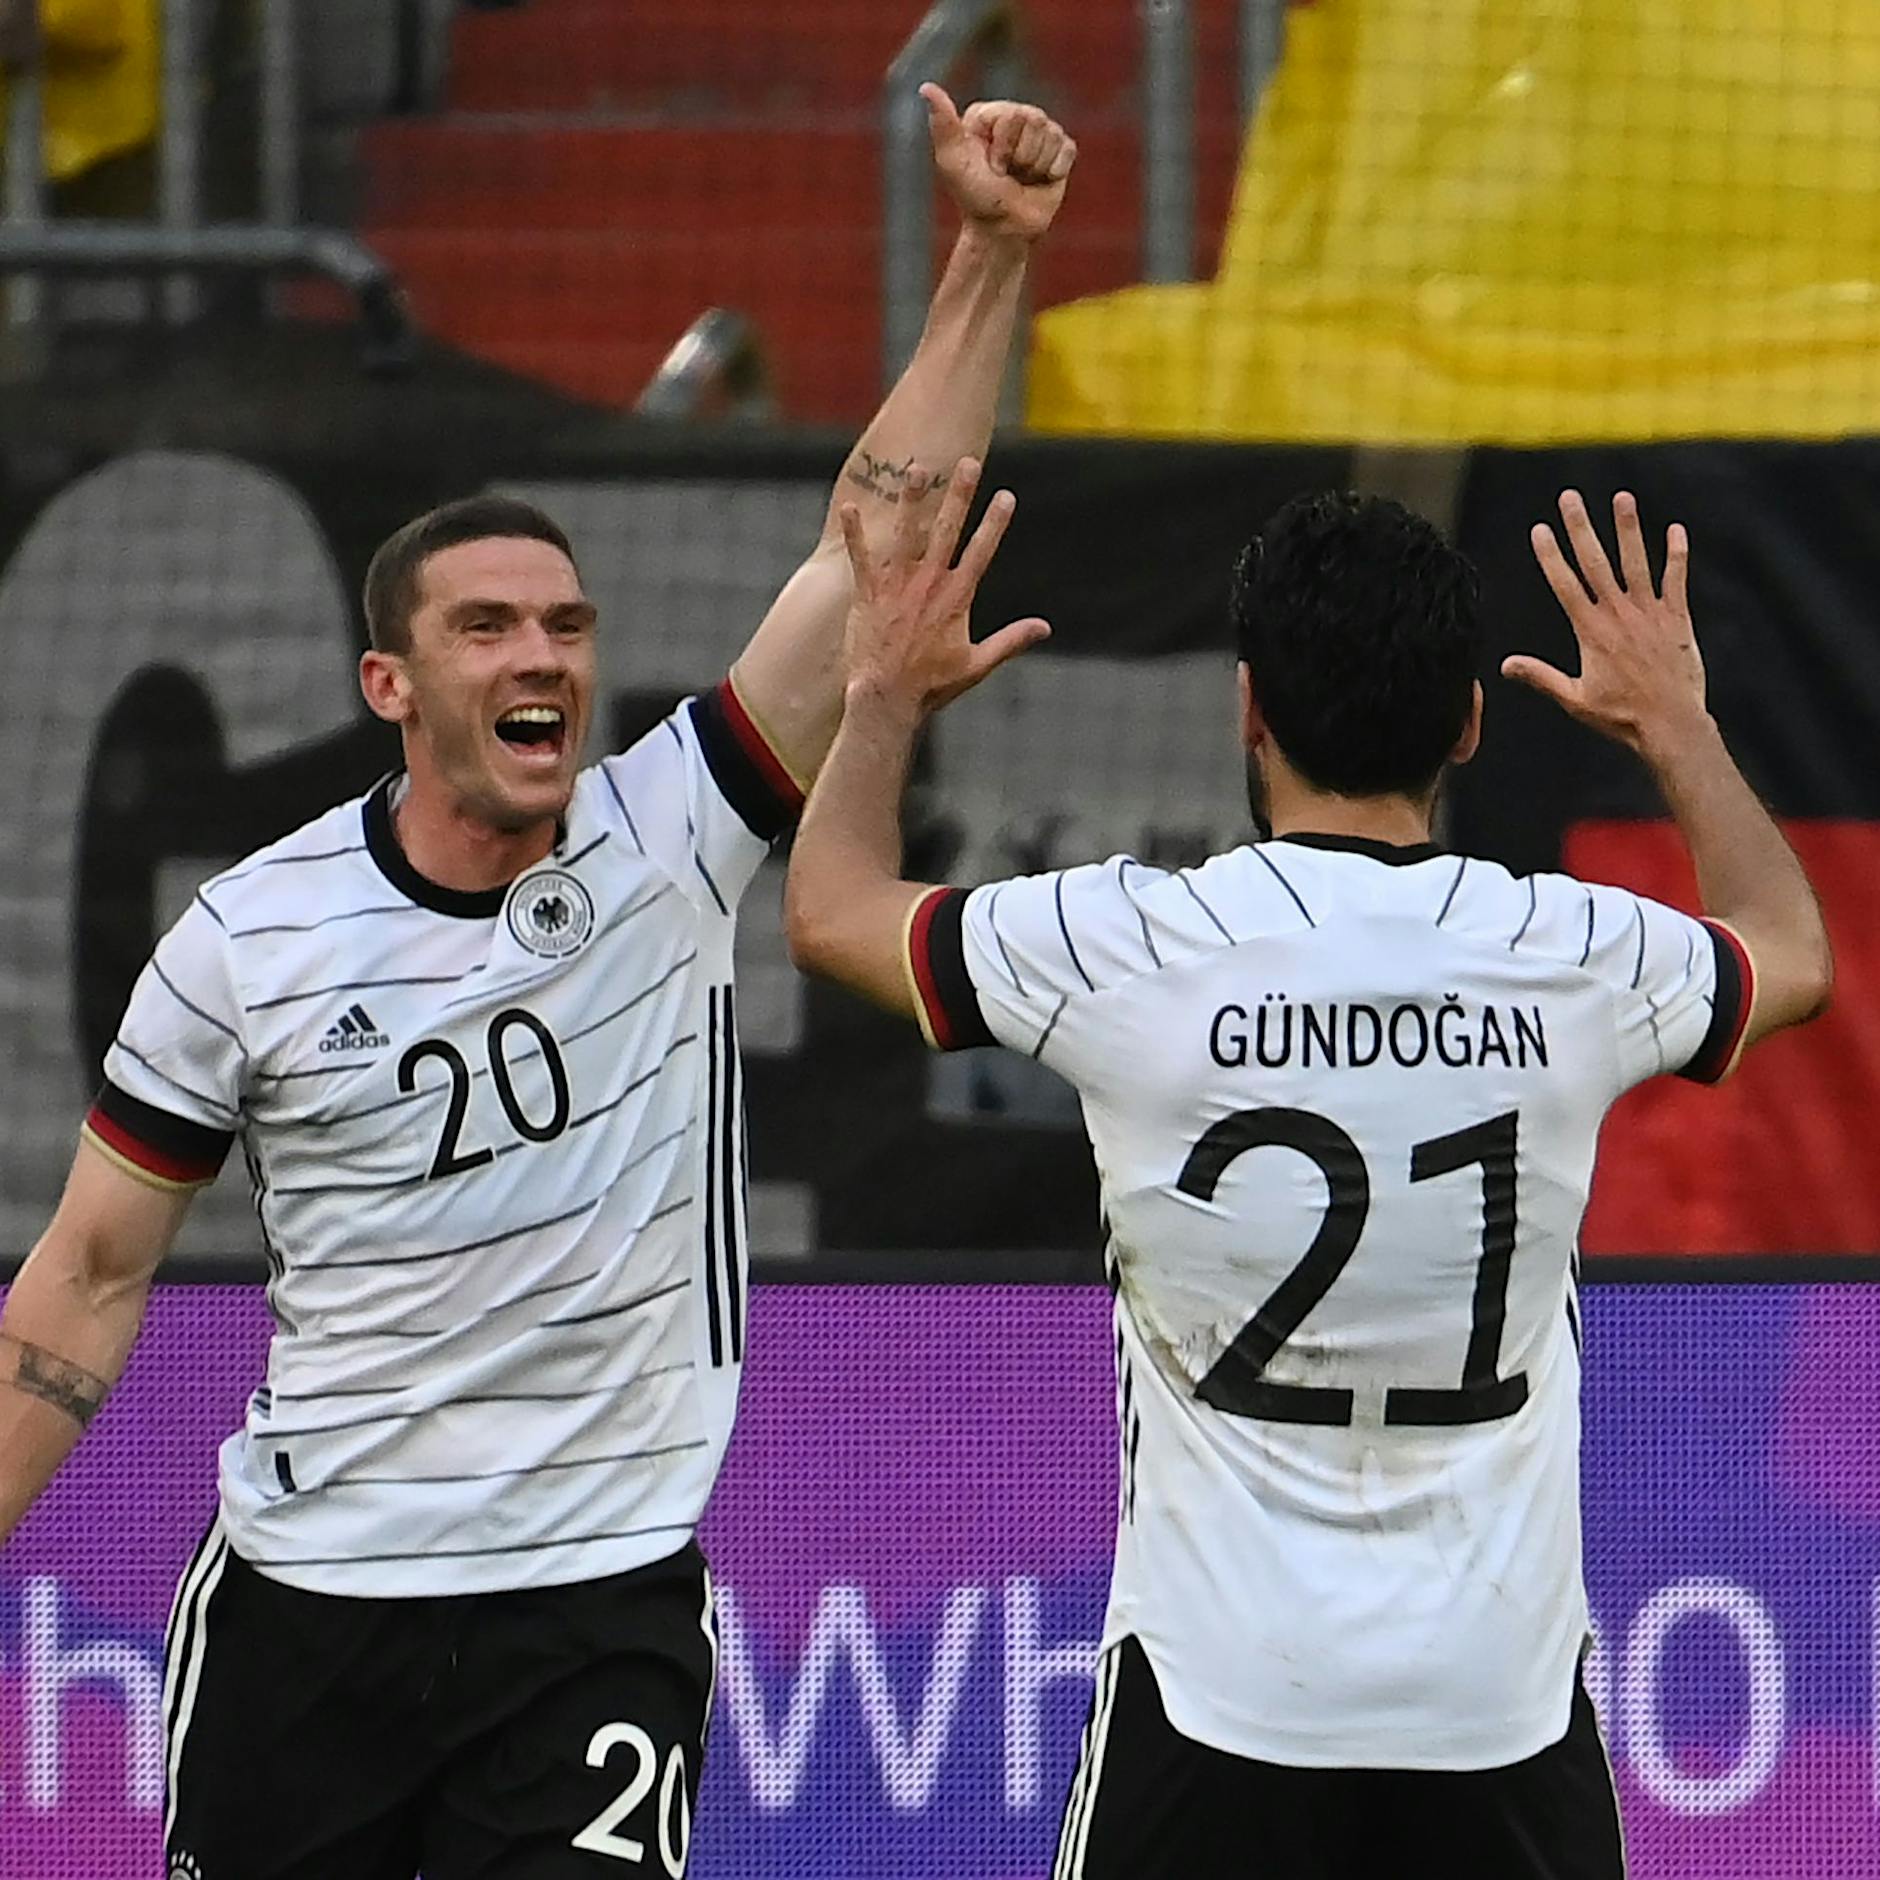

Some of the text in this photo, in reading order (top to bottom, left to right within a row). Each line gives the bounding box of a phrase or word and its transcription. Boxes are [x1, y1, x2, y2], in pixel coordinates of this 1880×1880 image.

[318, 1031, 391, 1053] adidas
[397, 1008, 570, 1180] 20
[1209, 992, 1549, 1069] GÜNDOĞAN
[1176, 1106, 1529, 1427] 21
[571, 1721, 691, 1880] 20
